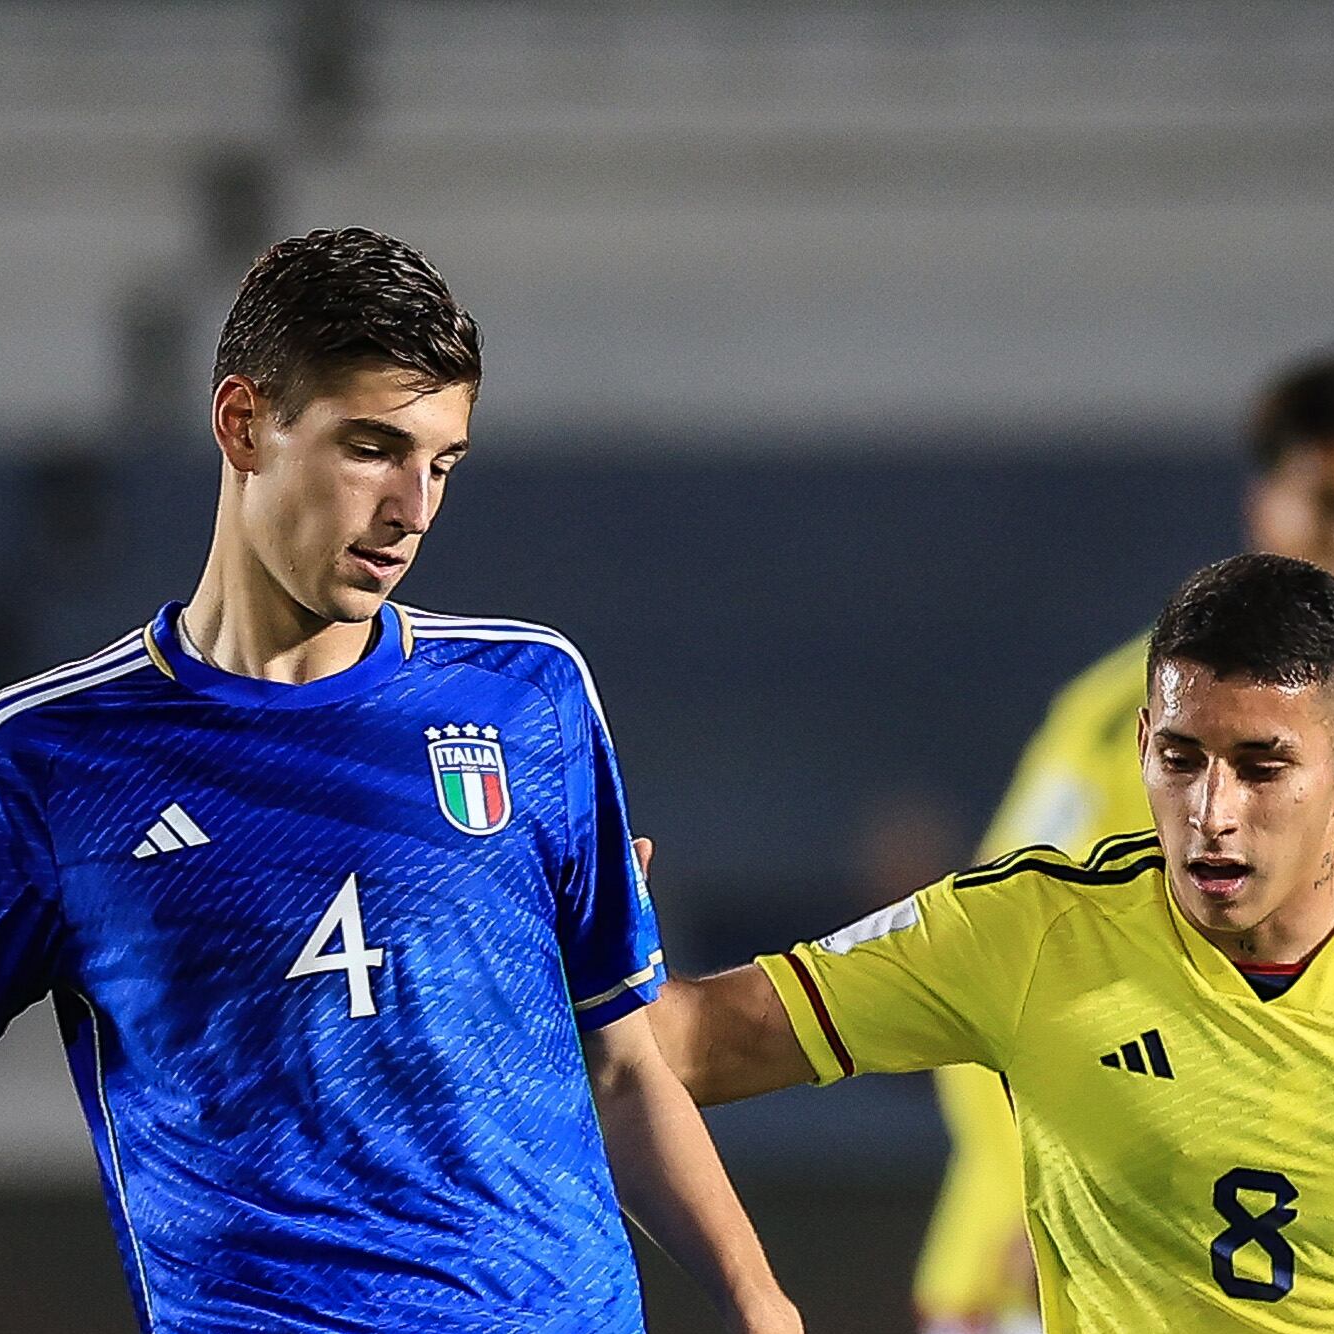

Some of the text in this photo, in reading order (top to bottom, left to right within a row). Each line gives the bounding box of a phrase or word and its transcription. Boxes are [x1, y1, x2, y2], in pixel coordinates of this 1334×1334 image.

[436, 747, 497, 766] ITALIA
[284, 871, 384, 1018] 4
[1210, 1166, 1300, 1303] 8
